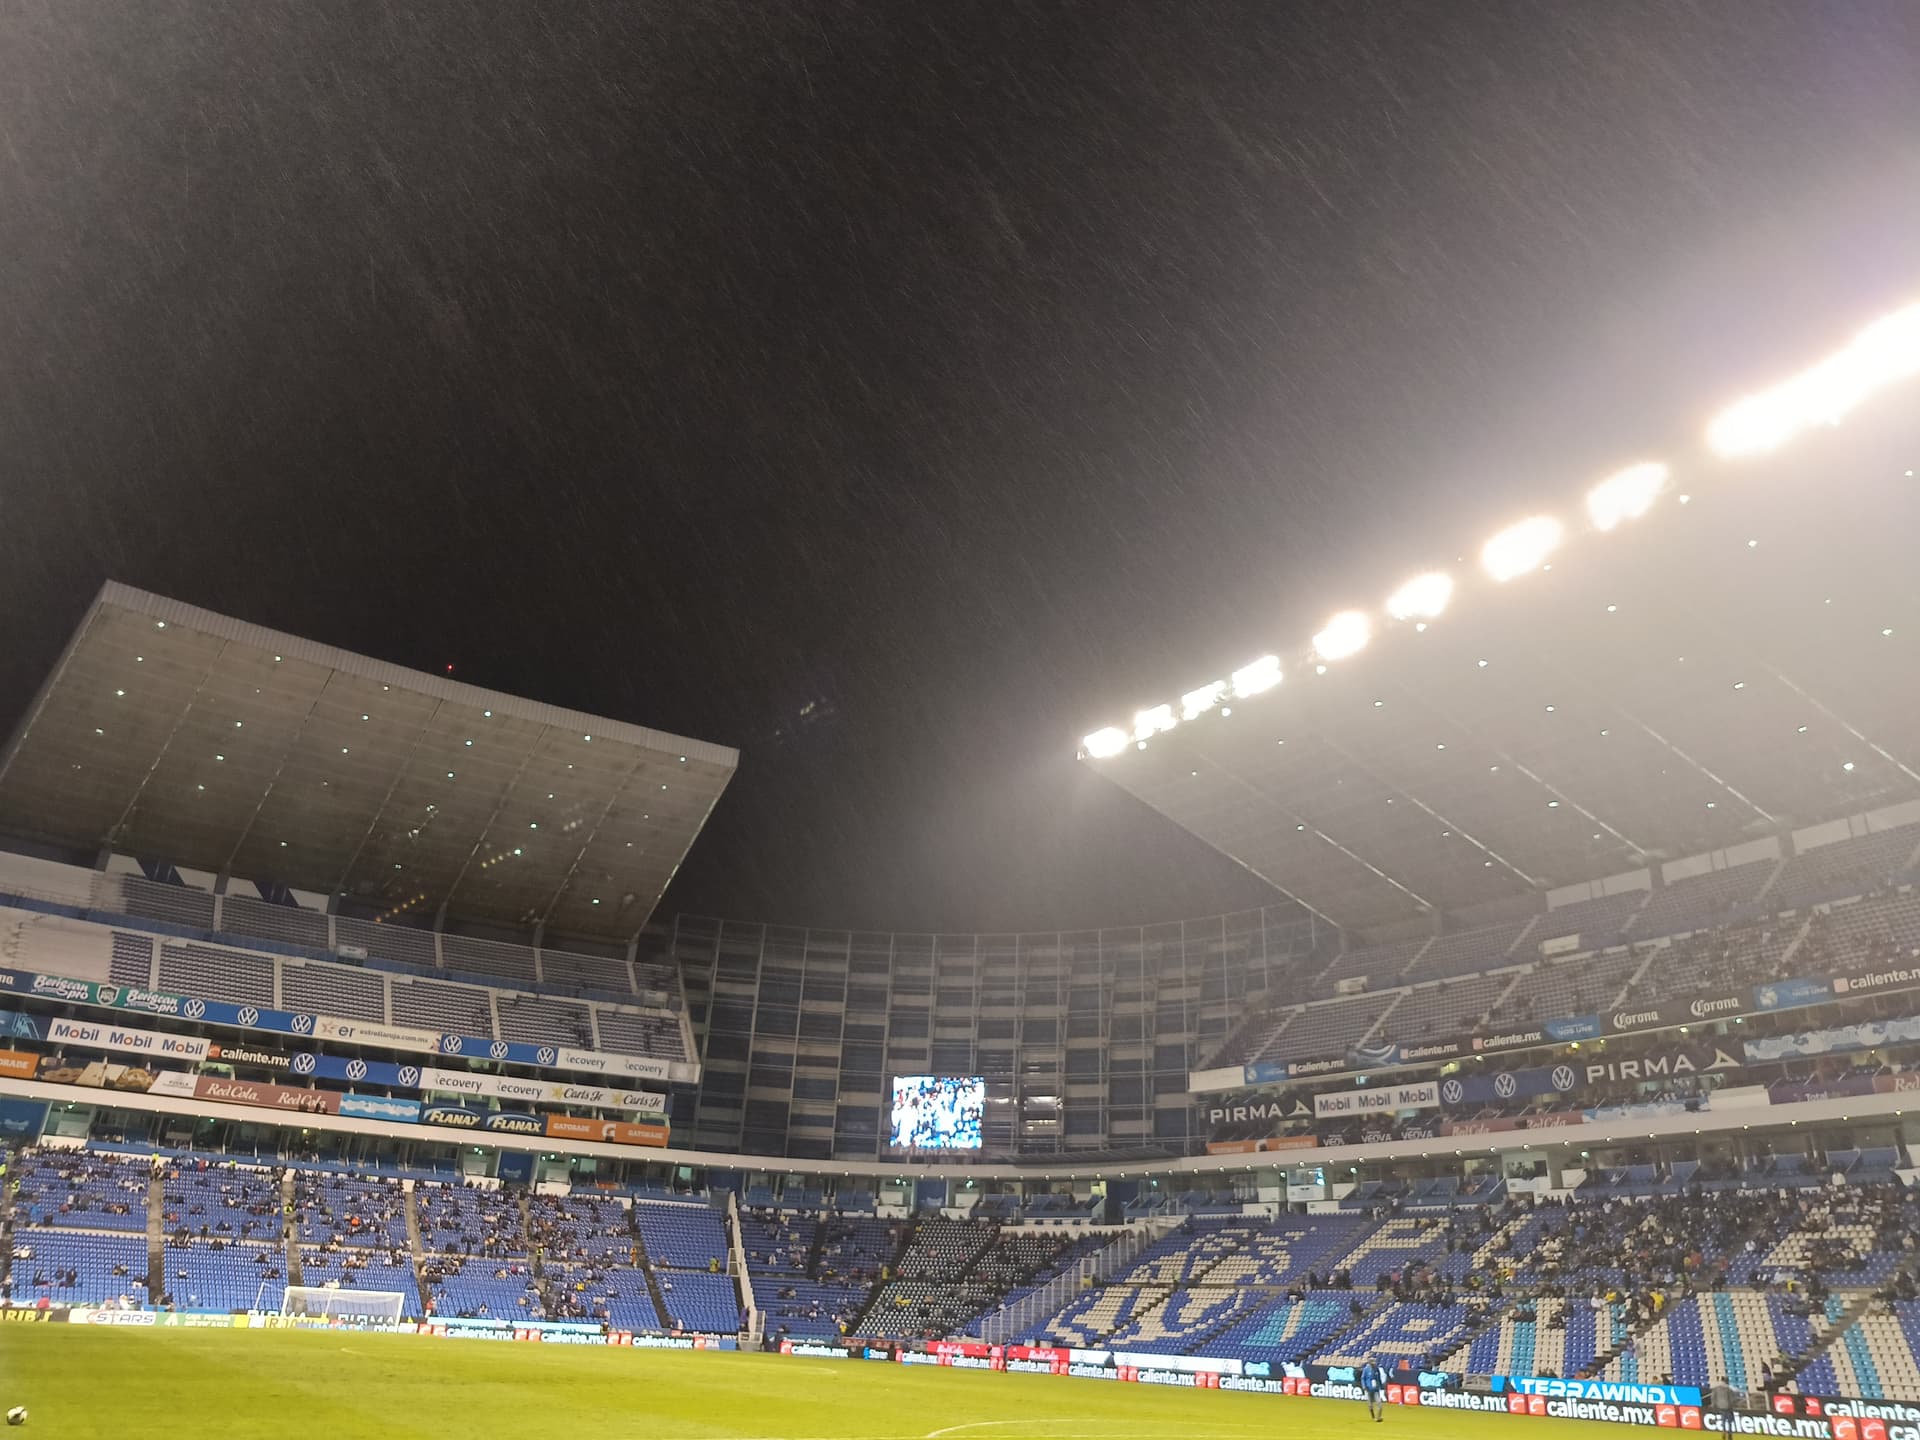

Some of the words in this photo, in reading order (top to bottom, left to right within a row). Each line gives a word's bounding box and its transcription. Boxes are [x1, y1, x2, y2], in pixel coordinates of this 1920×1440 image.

[1691, 997, 1739, 1017] Corona
[1613, 1010, 1659, 1029] Corona
[55, 1024, 99, 1041] Mobil
[109, 1032, 152, 1049] Mobil
[162, 1039, 204, 1056] Mobil
[338, 1025, 356, 1038] er
[1483, 1031, 1541, 1048] caliente.mx
[221, 1047, 290, 1067] caliente.mx
[1408, 1043, 1458, 1058] caliente.mx
[1297, 1059, 1345, 1073] caliente.mx
[1586, 1053, 1696, 1084] PIRMA
[206, 1083, 229, 1097] Red
[230, 1084, 258, 1101] Cola
[1319, 1098, 1351, 1112] Mobil
[1358, 1093, 1391, 1108] Mobil
[1399, 1089, 1433, 1103] Mobil
[1210, 1103, 1283, 1124] PIRMA
[492, 1117, 541, 1132] FLANAX
[632, 1335, 693, 1349] caliente.mx
[791, 1343, 848, 1358] caliente.mx
[1007, 1360, 1050, 1373] caliente.mx
[1069, 1363, 1118, 1380] caliente.mx
[1138, 1367, 1196, 1386] caliente.mx
[1219, 1375, 1282, 1393] caliente.mx
[1310, 1381, 1387, 1402] caliente.x
[1420, 1388, 1508, 1413] caliente.mx
[1521, 1379, 1666, 1404] TERRAWIND
[1547, 1397, 1656, 1426] caliente.mx
[1704, 1412, 1832, 1440] caiente.mx
